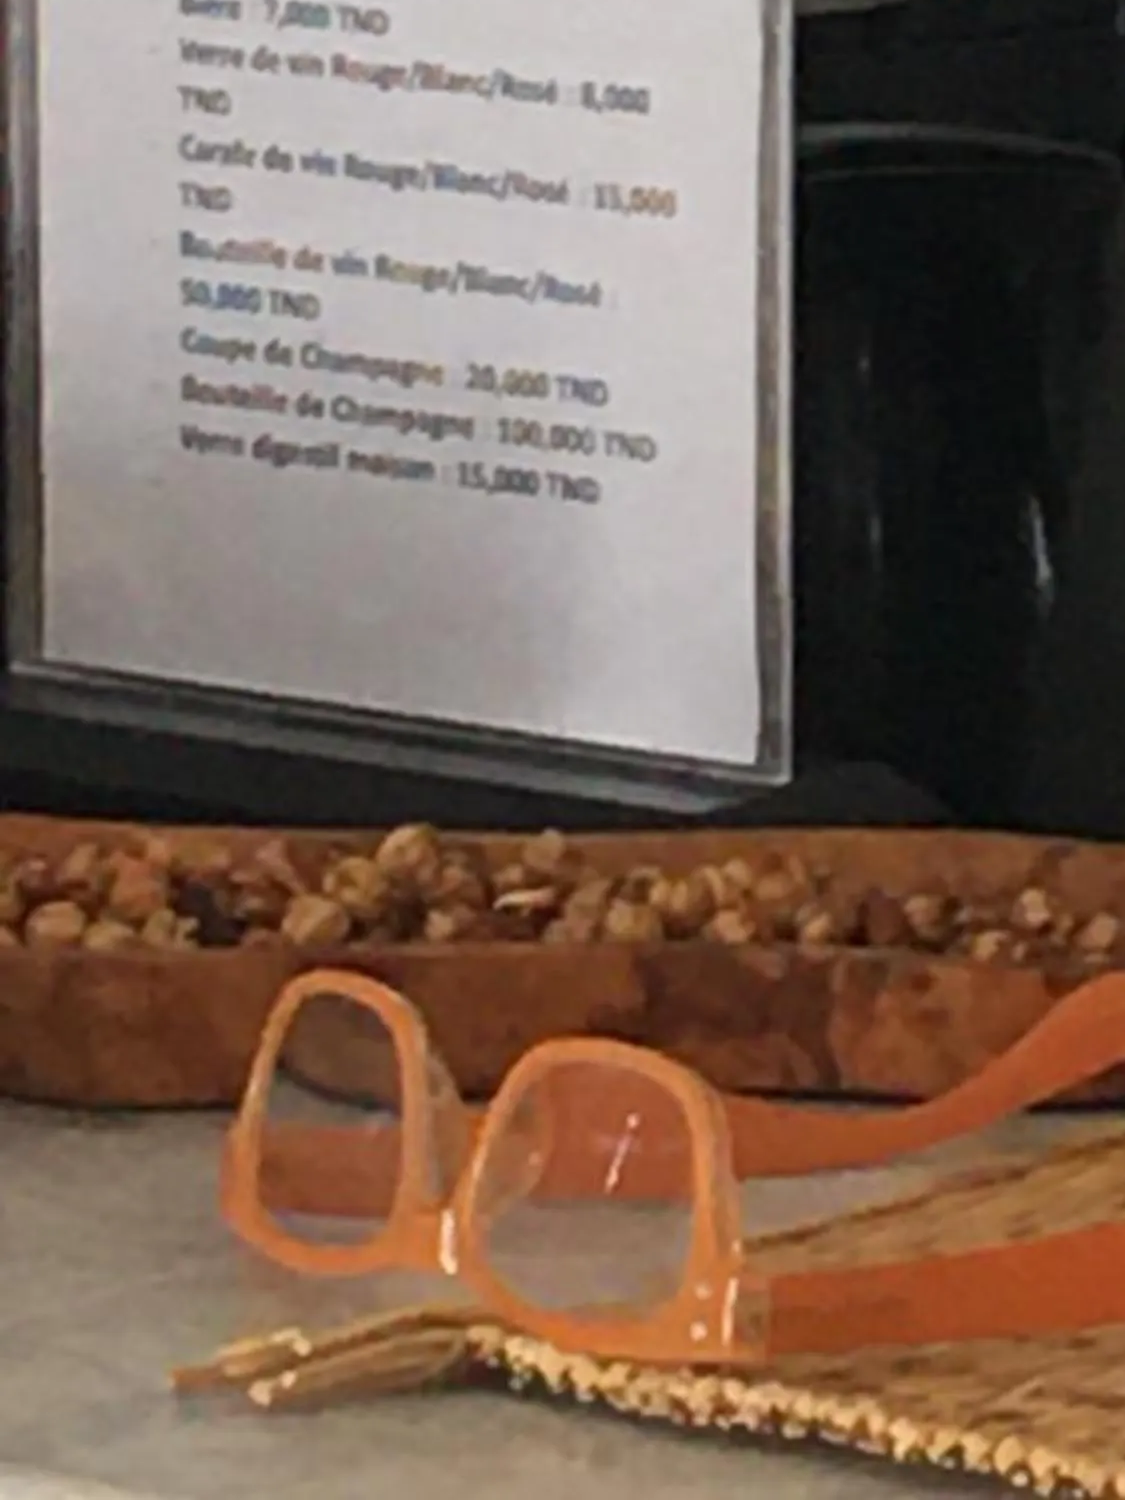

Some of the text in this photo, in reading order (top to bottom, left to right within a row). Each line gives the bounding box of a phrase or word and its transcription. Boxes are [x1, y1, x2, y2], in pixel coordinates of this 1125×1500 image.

[335, 4, 390, 37] TND
[249, 45, 281, 74] de
[287, 54, 325, 78] vin
[178, 85, 231, 116] TND
[262, 144, 294, 173] de
[299, 150, 338, 177] vin
[178, 181, 232, 213] TND
[293, 246, 324, 273] de
[331, 250, 369, 276] vin
[267, 288, 320, 321] TND
[263, 338, 293, 368] de
[554, 375, 609, 407] TND
[294, 391, 325, 420] de
[603, 431, 657, 463] TND
[545, 471, 601, 505] TND
